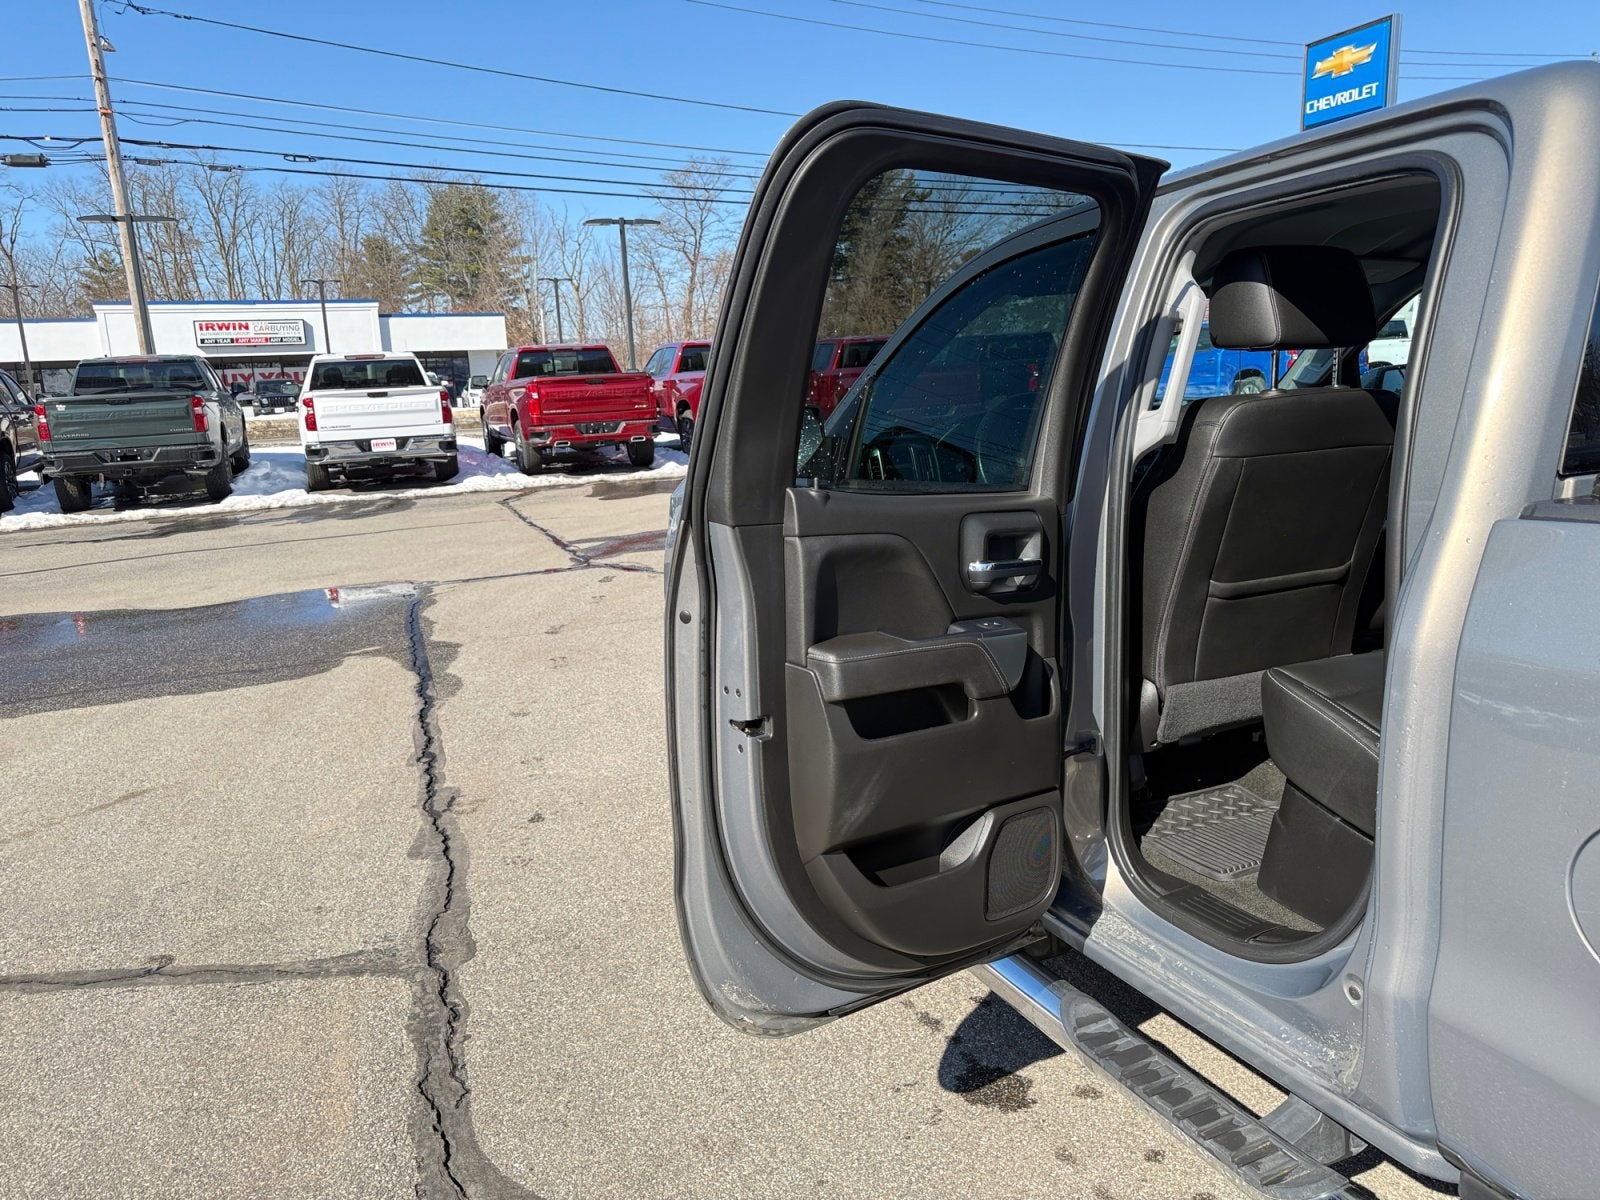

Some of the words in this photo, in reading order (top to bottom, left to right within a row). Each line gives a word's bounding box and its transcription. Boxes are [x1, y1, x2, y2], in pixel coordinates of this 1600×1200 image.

[1305, 81, 1379, 114] CHEVROLET
[198, 322, 250, 332] IRWIN
[220, 372, 253, 388] UY
[323, 400, 433, 413] CHEVROLET
